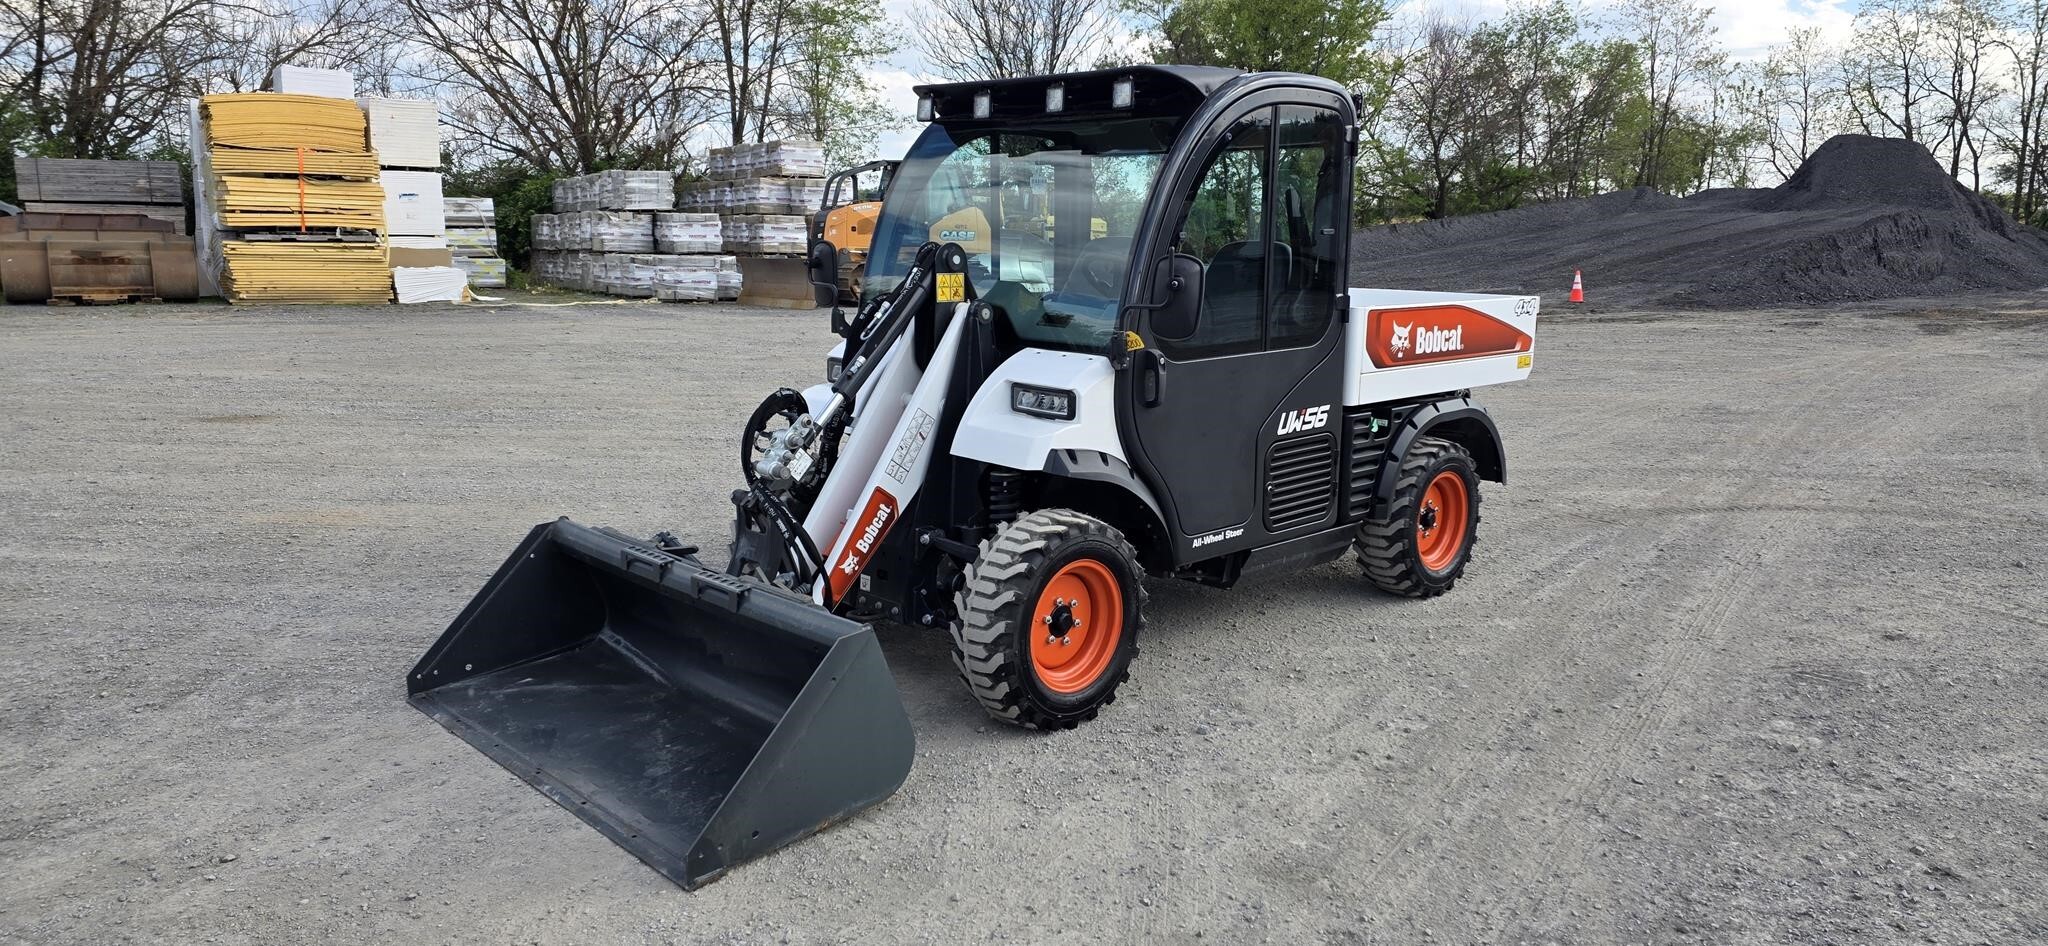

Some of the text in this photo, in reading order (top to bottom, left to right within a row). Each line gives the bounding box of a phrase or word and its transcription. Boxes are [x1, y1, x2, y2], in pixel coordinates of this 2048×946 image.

[940, 230, 975, 241] CASE
[1514, 298, 1537, 316] 4x4
[1416, 324, 1463, 355] Bobcat
[855, 503, 893, 554] Bobcat
[1192, 528, 1244, 549] All-Wheel Steer
